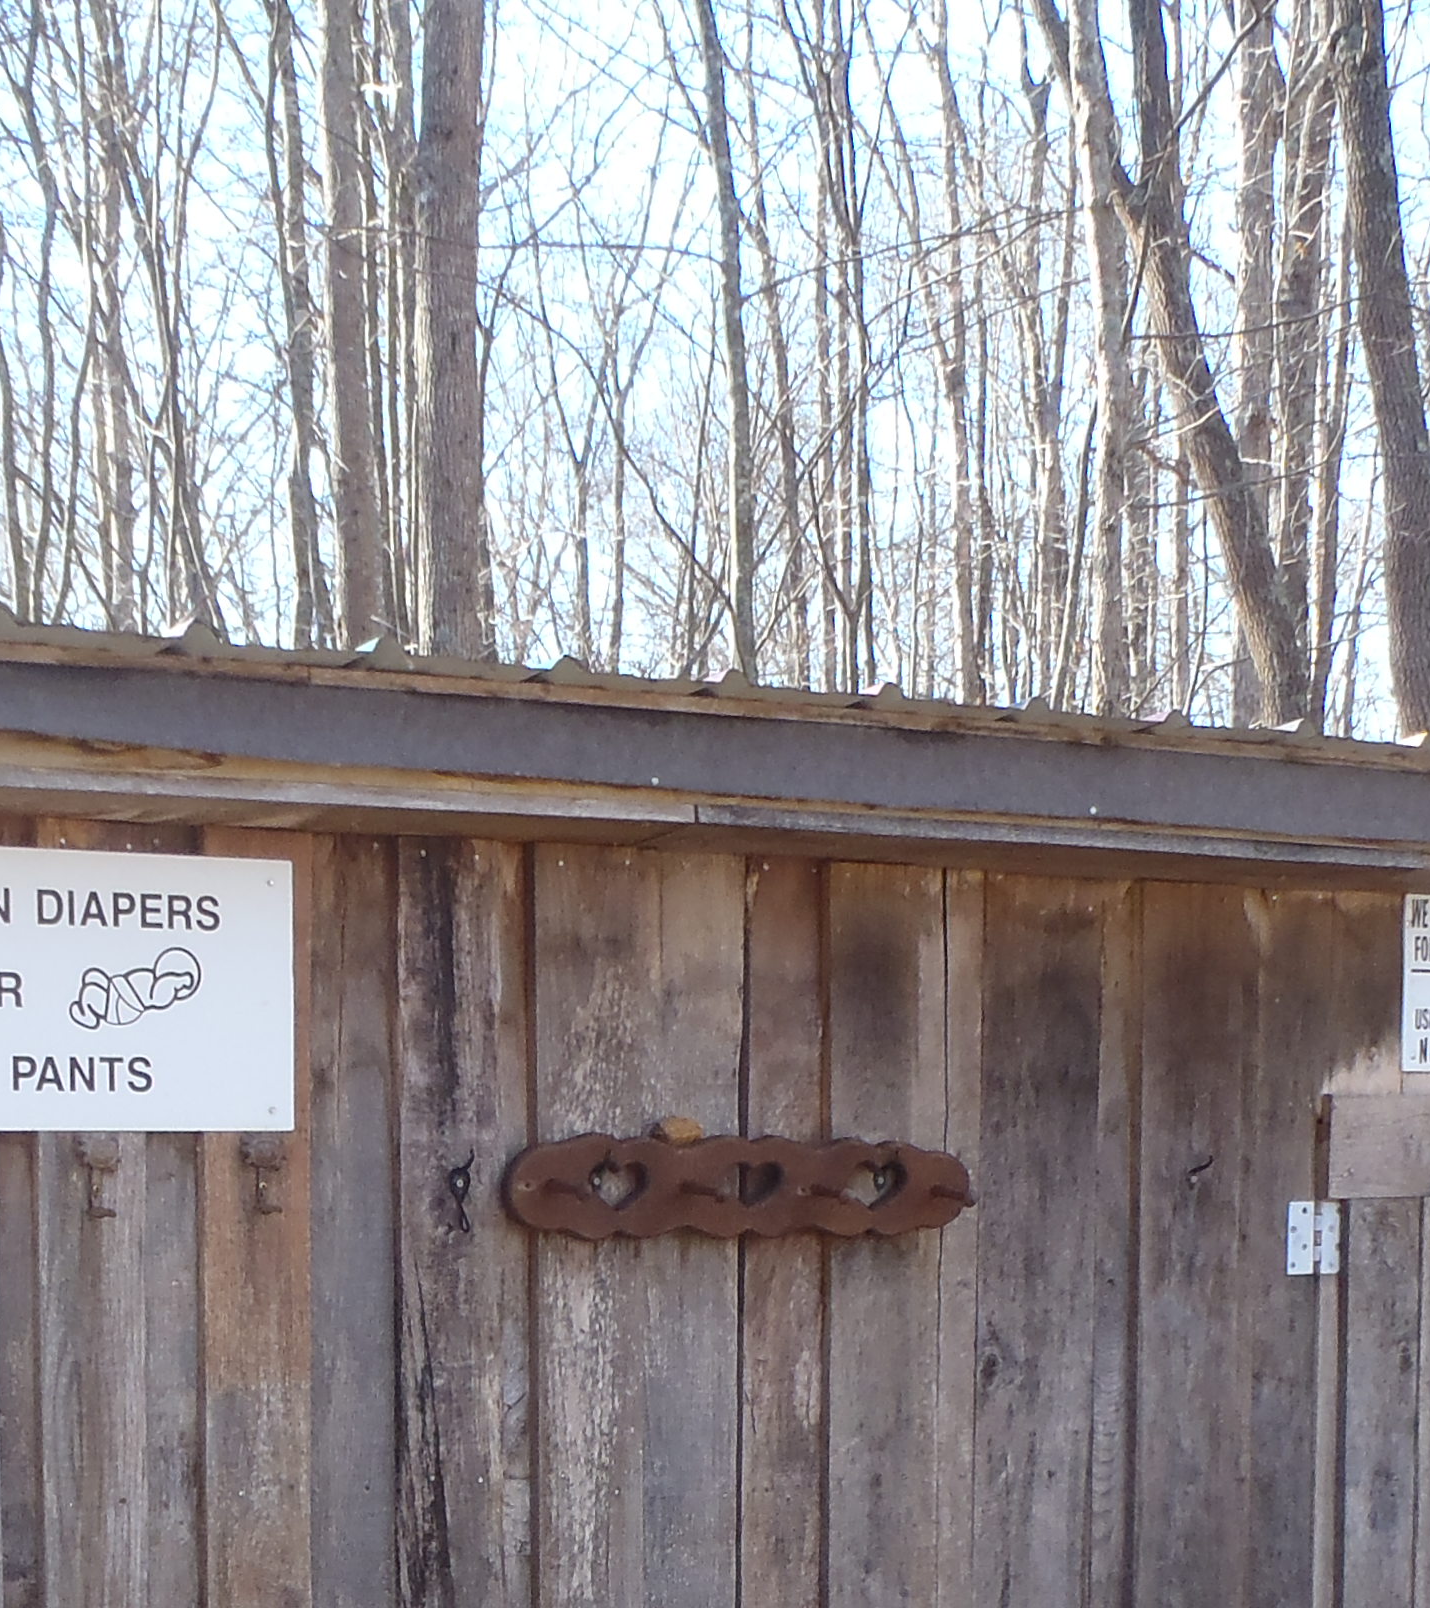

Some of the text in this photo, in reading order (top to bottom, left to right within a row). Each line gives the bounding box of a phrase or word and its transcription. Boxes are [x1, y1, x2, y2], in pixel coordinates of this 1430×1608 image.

[37, 888, 221, 932] DIAPERS
[1411, 899, 1428, 928] WE
[12, 1055, 154, 1094] PANTS
